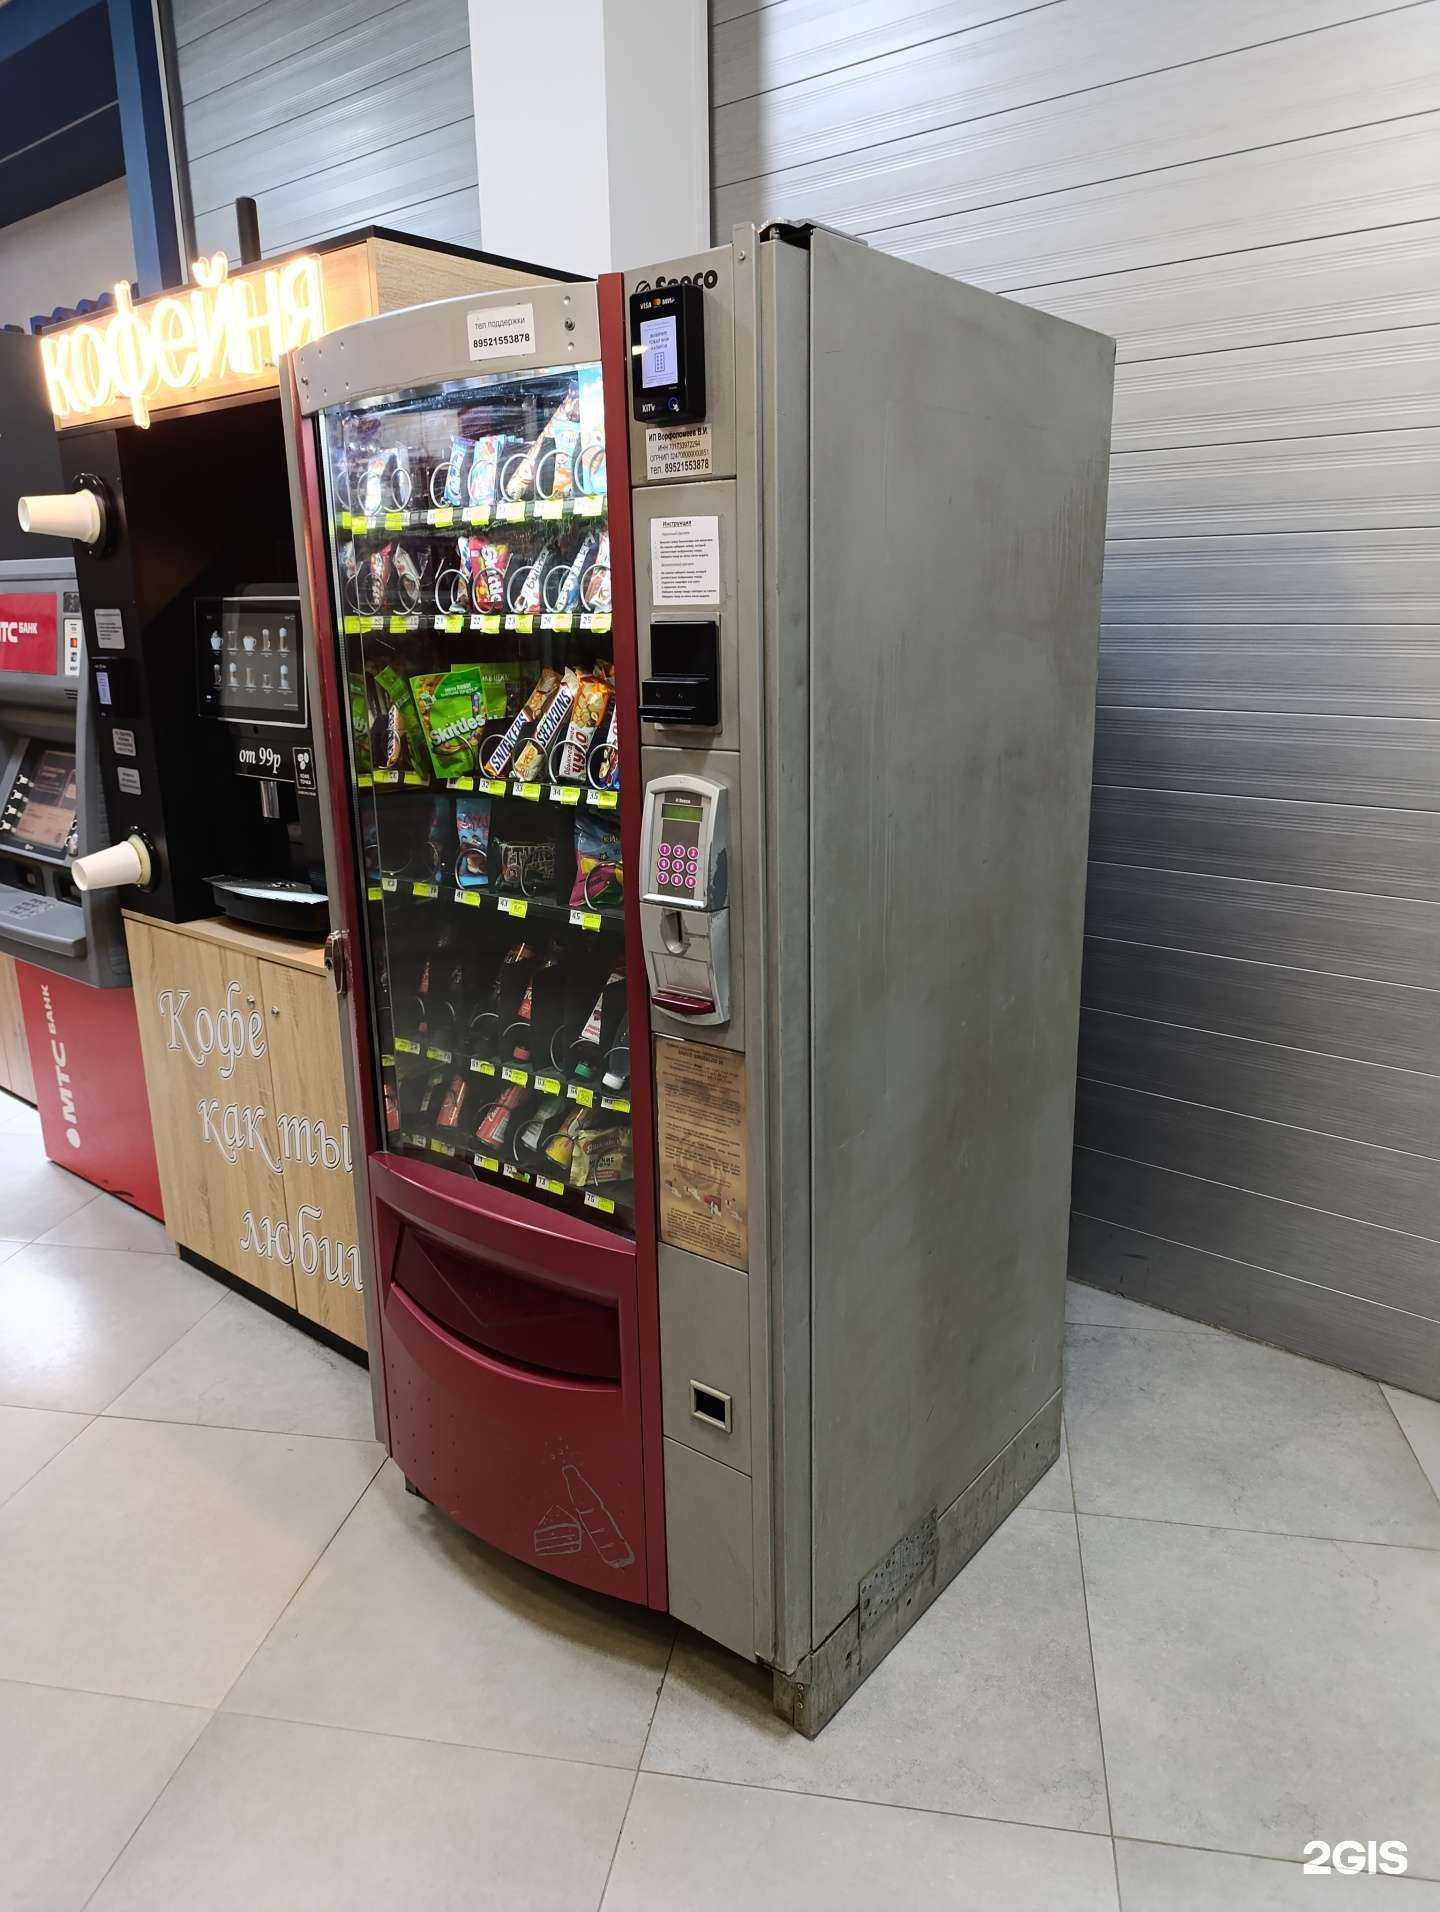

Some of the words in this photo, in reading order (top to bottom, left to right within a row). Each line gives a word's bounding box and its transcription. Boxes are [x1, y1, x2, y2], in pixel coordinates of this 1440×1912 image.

[640, 302, 653, 310] VISA
[488, 317, 526, 329] поддержки
[473, 333, 530, 348] 89521553878
[649, 433, 657, 442] ИП
[664, 458, 709, 473] 89521553878
[0, 621, 18, 643] ТС
[19, 622, 38, 634] БАНК
[430, 714, 486, 745] Skittles
[536, 689, 572, 747] SNICKERS
[490, 711, 528, 772] SNICKERS
[41, 984, 57, 1035] БАНК
[159, 980, 266, 1078] Кофе
[51, 1039, 78, 1124] МТС
[199, 1098, 284, 1174] как
[277, 1112, 353, 1174] ты
